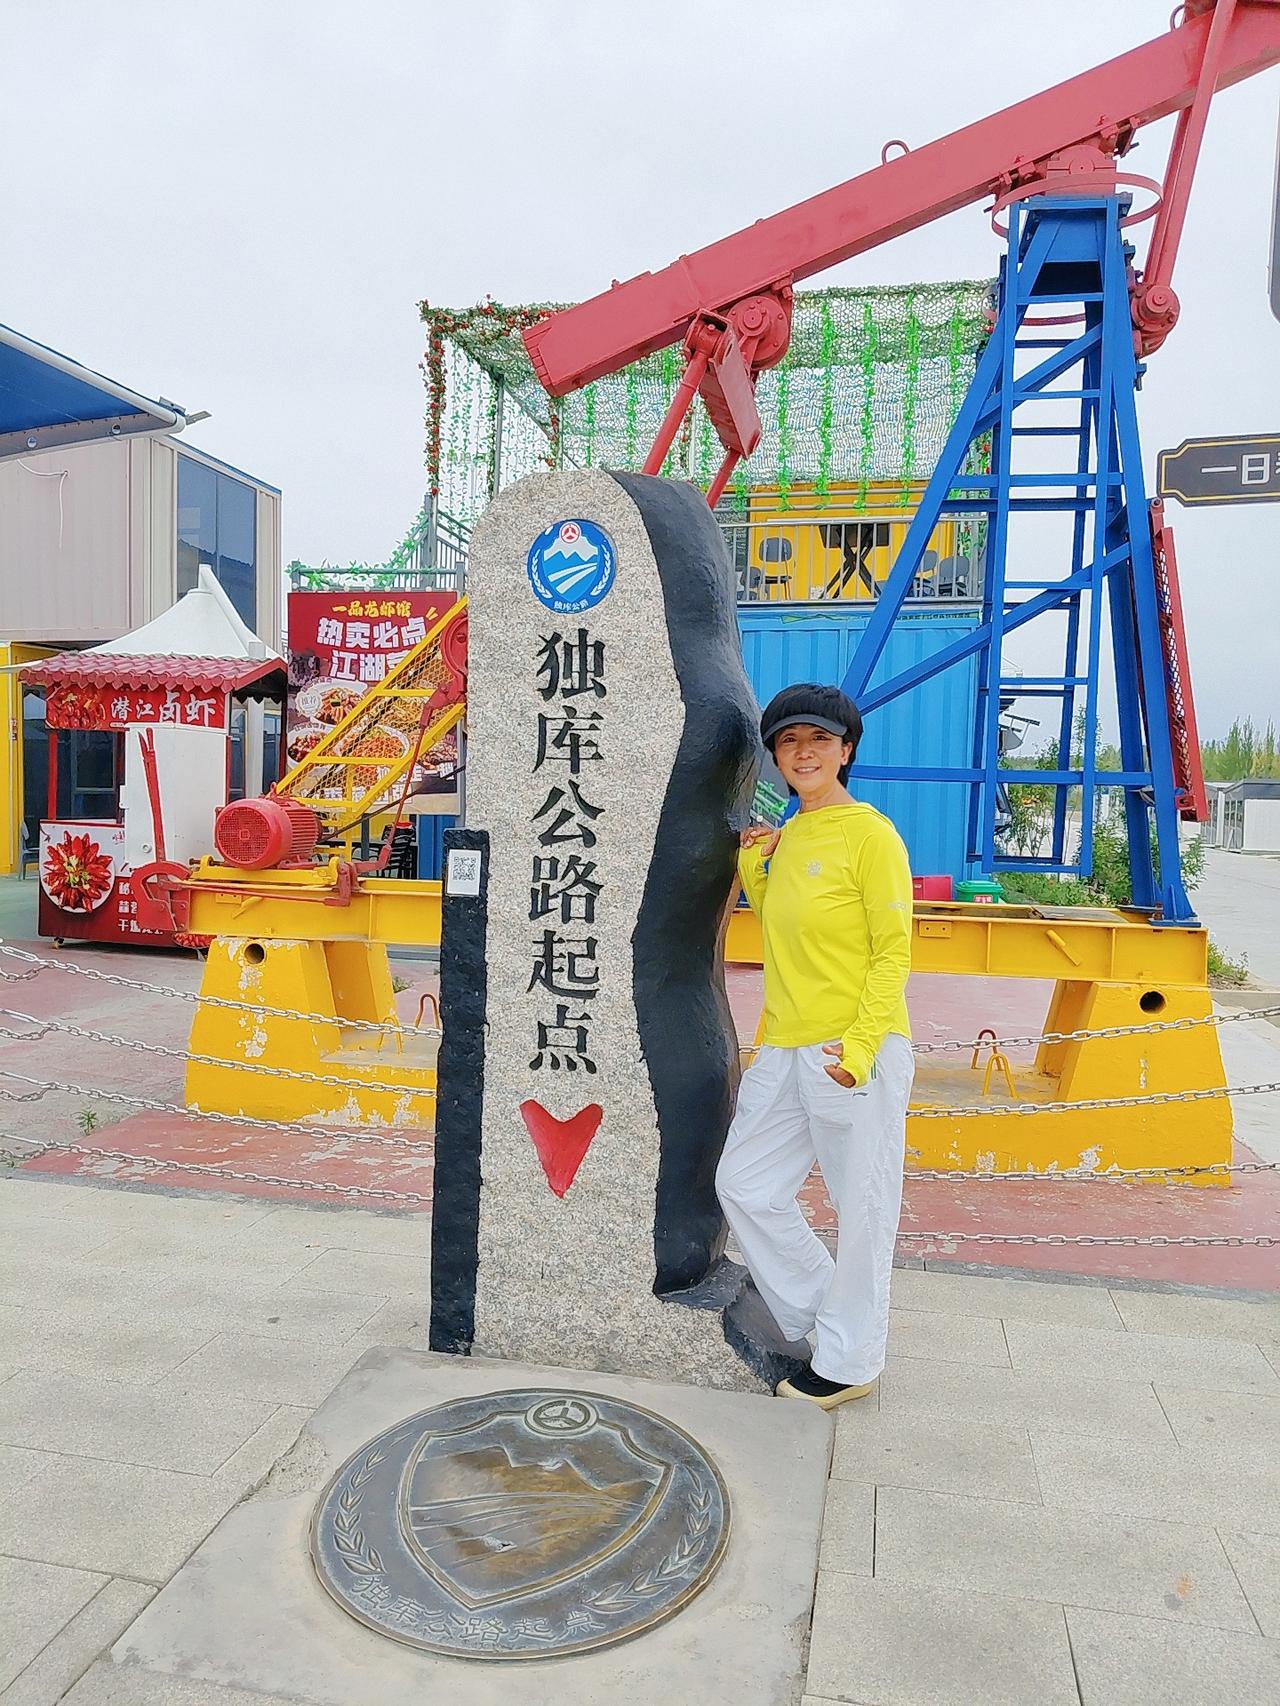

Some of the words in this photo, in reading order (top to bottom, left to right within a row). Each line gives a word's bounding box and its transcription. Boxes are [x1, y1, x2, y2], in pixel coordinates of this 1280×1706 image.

[1201, 452, 1280, 485] 一日
[316, 616, 427, 649] 热卖必点
[110, 690, 217, 727] 潜江卤虾
[526, 627, 607, 1075] 独库公路起点
[351, 1576, 606, 1643] 独库公路起点
